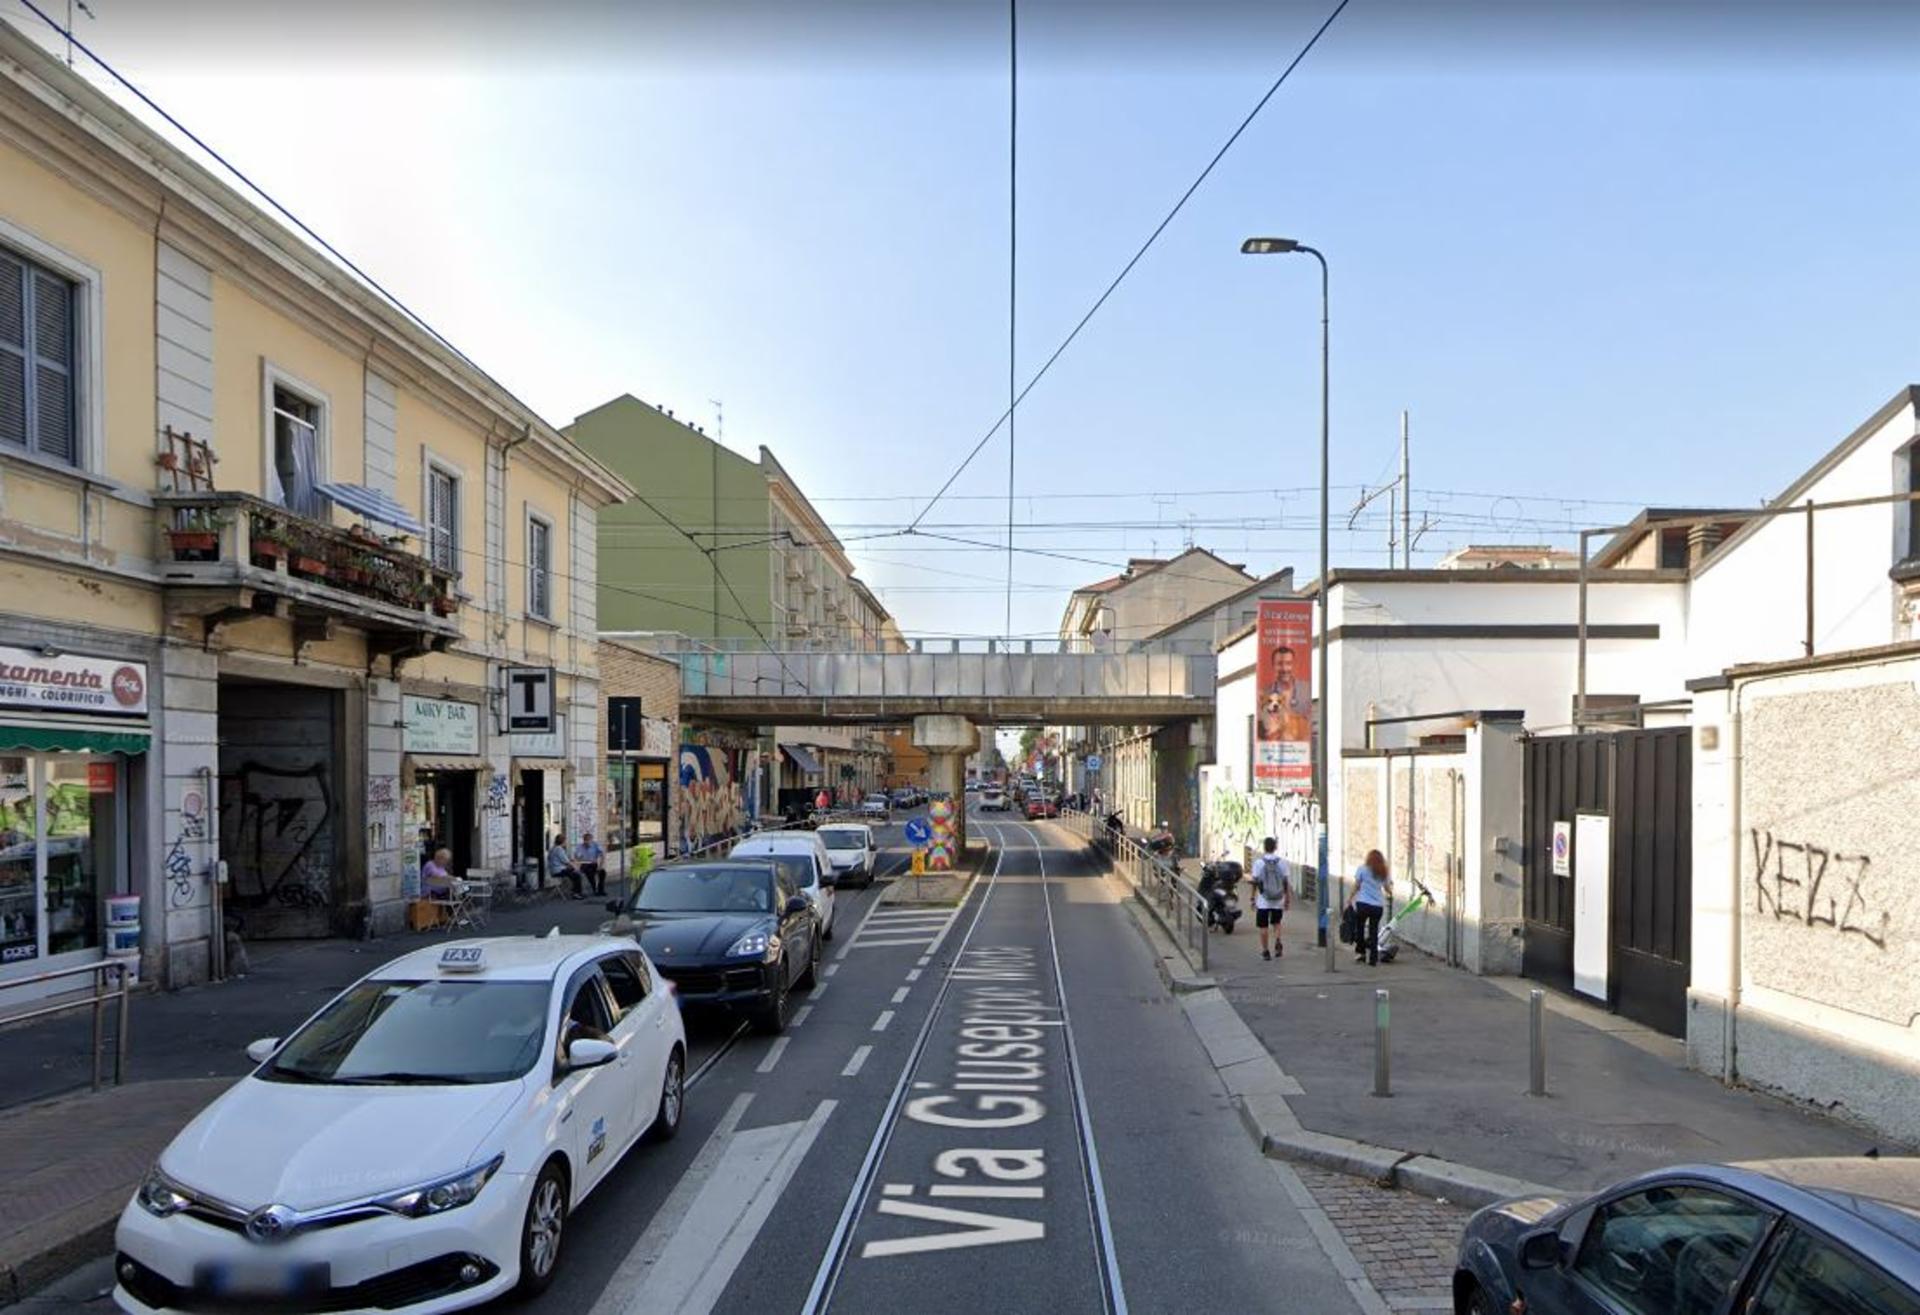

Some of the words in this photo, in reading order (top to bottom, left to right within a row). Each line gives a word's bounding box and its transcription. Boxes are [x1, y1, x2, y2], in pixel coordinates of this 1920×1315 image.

[41, 688, 105, 705] COLORIFICIO
[513, 674, 546, 712] T
[447, 705, 466, 720] BAR
[443, 949, 481, 961] TAXI
[905, 986, 1068, 1128] Giuseppe
[861, 1149, 1045, 1258] Via
